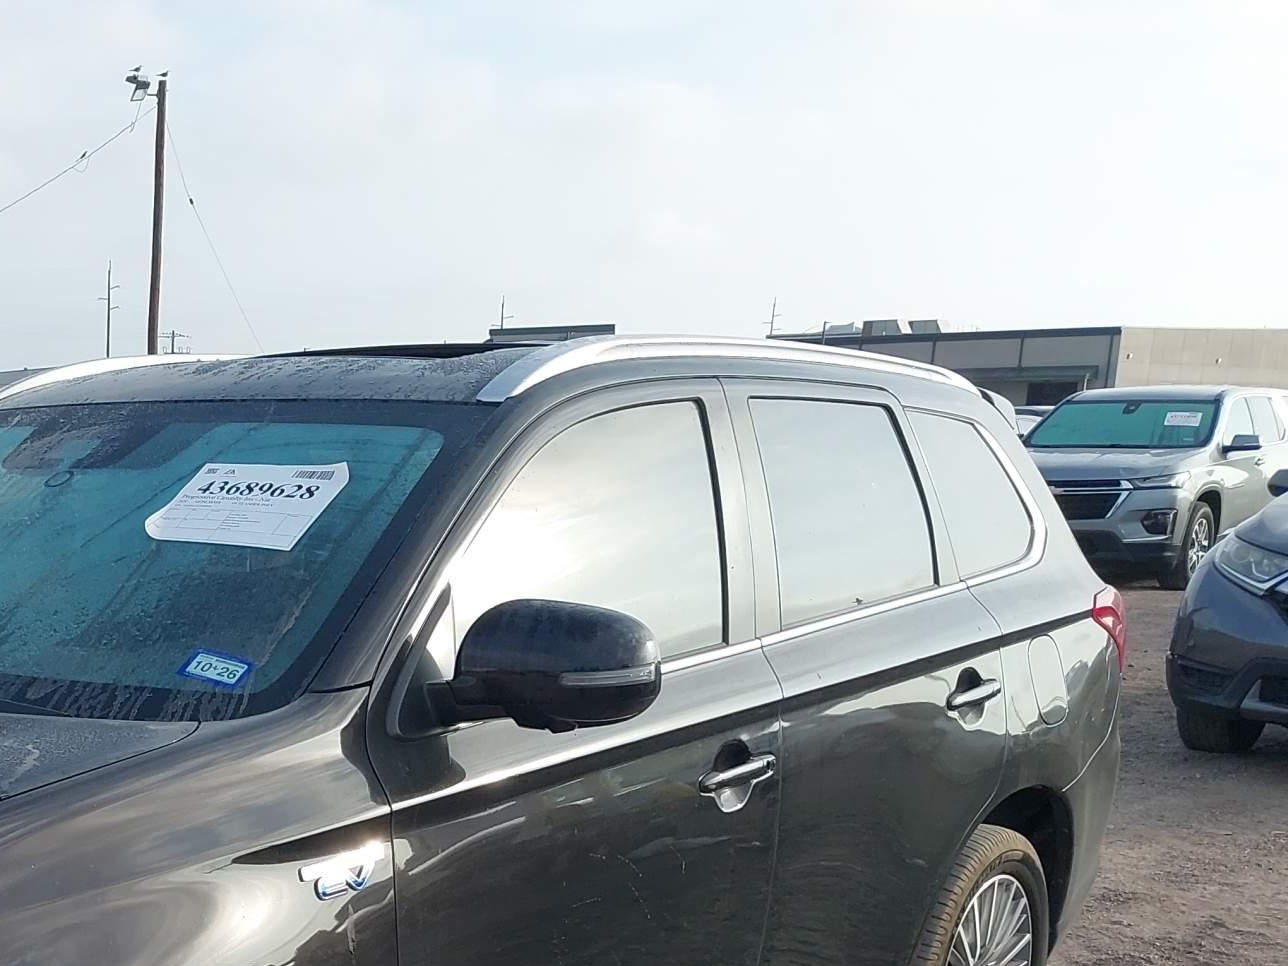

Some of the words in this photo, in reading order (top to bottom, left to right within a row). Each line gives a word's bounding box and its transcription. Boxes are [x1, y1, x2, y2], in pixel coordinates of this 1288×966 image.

[197, 480, 321, 500] 43689628
[193, 660, 213, 673] 10
[216, 666, 240, 680] 26
